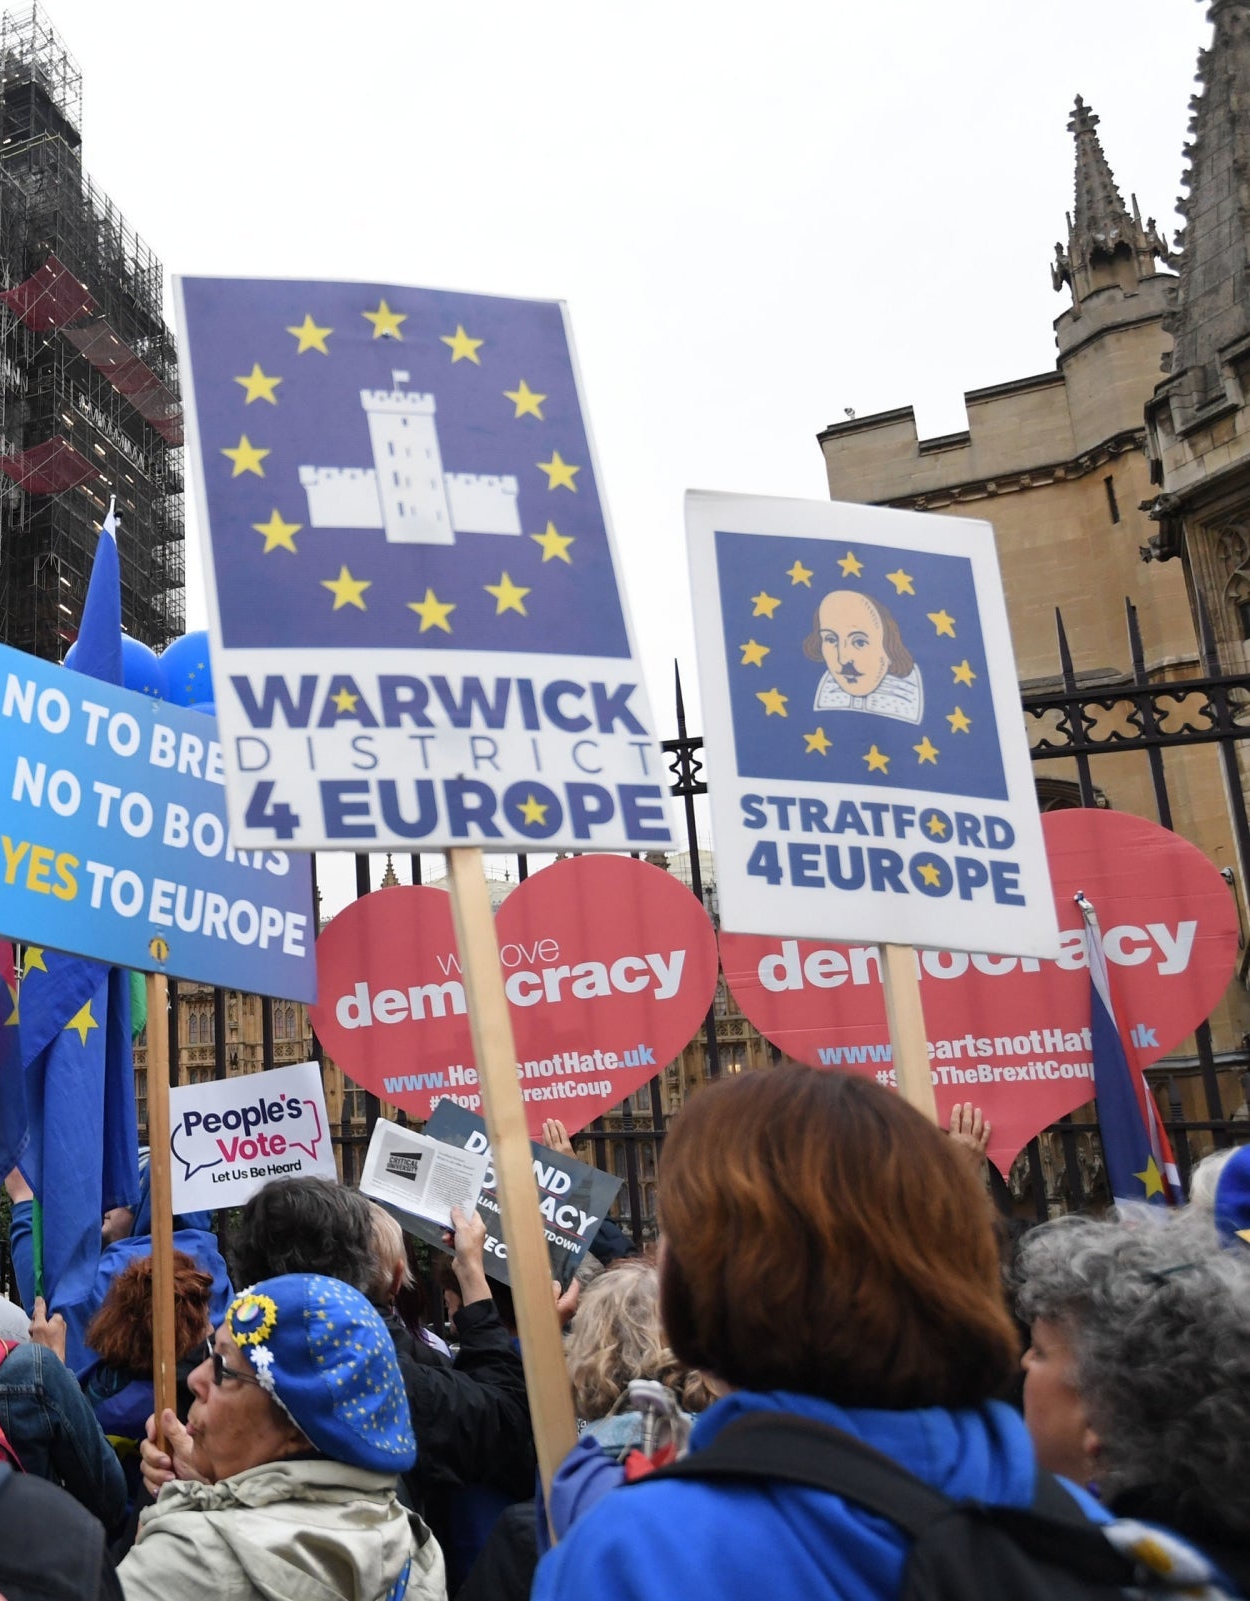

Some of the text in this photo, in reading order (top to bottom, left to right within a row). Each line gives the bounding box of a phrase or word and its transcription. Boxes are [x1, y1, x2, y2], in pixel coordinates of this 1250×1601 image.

[2, 673, 227, 786] NO TO BRE
[230, 674, 649, 736] WARWICK
[236, 735, 653, 776] DISTRICT
[12, 756, 81, 817] NO
[93, 781, 153, 838] TO
[244, 779, 672, 842] 4 EUROPE
[740, 793, 1015, 850] STRATFORD
[1, 835, 307, 957] YES TO EUROPE
[747, 840, 1026, 907] 4EUROPE
[436, 938, 560, 976] w ove
[335, 949, 686, 1029] demcracy
[383, 1044, 656, 1094] www.HesnotHate.uk
[183, 1094, 302, 1136] People's
[212, 1160, 302, 1183] Let Us Be Heard
[216, 1133, 286, 1162] Vote
[544, 1230, 581, 1254] TDOWN
